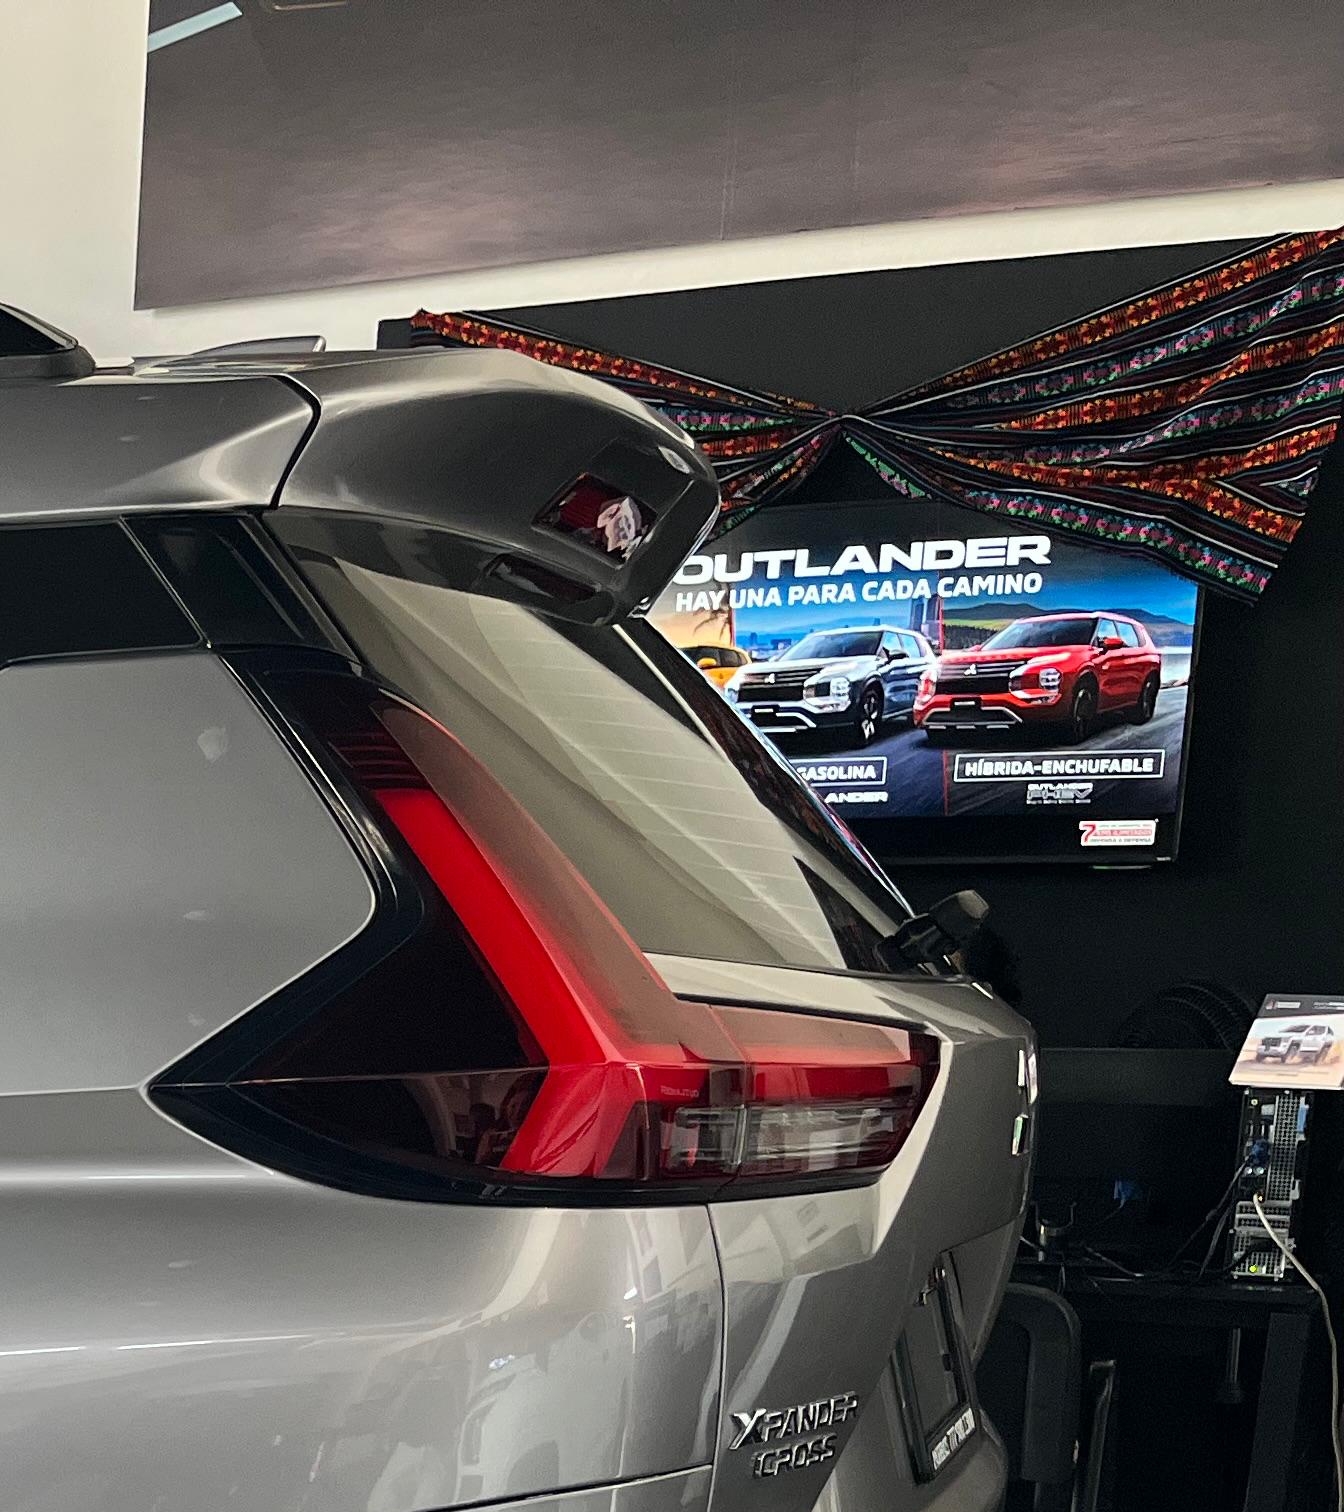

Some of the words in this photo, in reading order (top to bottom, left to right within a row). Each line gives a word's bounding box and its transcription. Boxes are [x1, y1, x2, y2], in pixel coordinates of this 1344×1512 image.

[672, 535, 1052, 586] OUTLANDER
[675, 588, 728, 613] HAY
[731, 585, 779, 608] UNA
[788, 581, 854, 606] PARA
[862, 577, 932, 601] CADA
[936, 571, 1043, 598] CAMINO
[797, 765, 876, 781] GASOLINA
[965, 758, 1154, 777] HÍBRIDA-ENCHUFABLE
[824, 791, 888, 804] ANDER
[729, 1391, 859, 1450] XPANDER
[752, 1433, 838, 1479] CROSS
